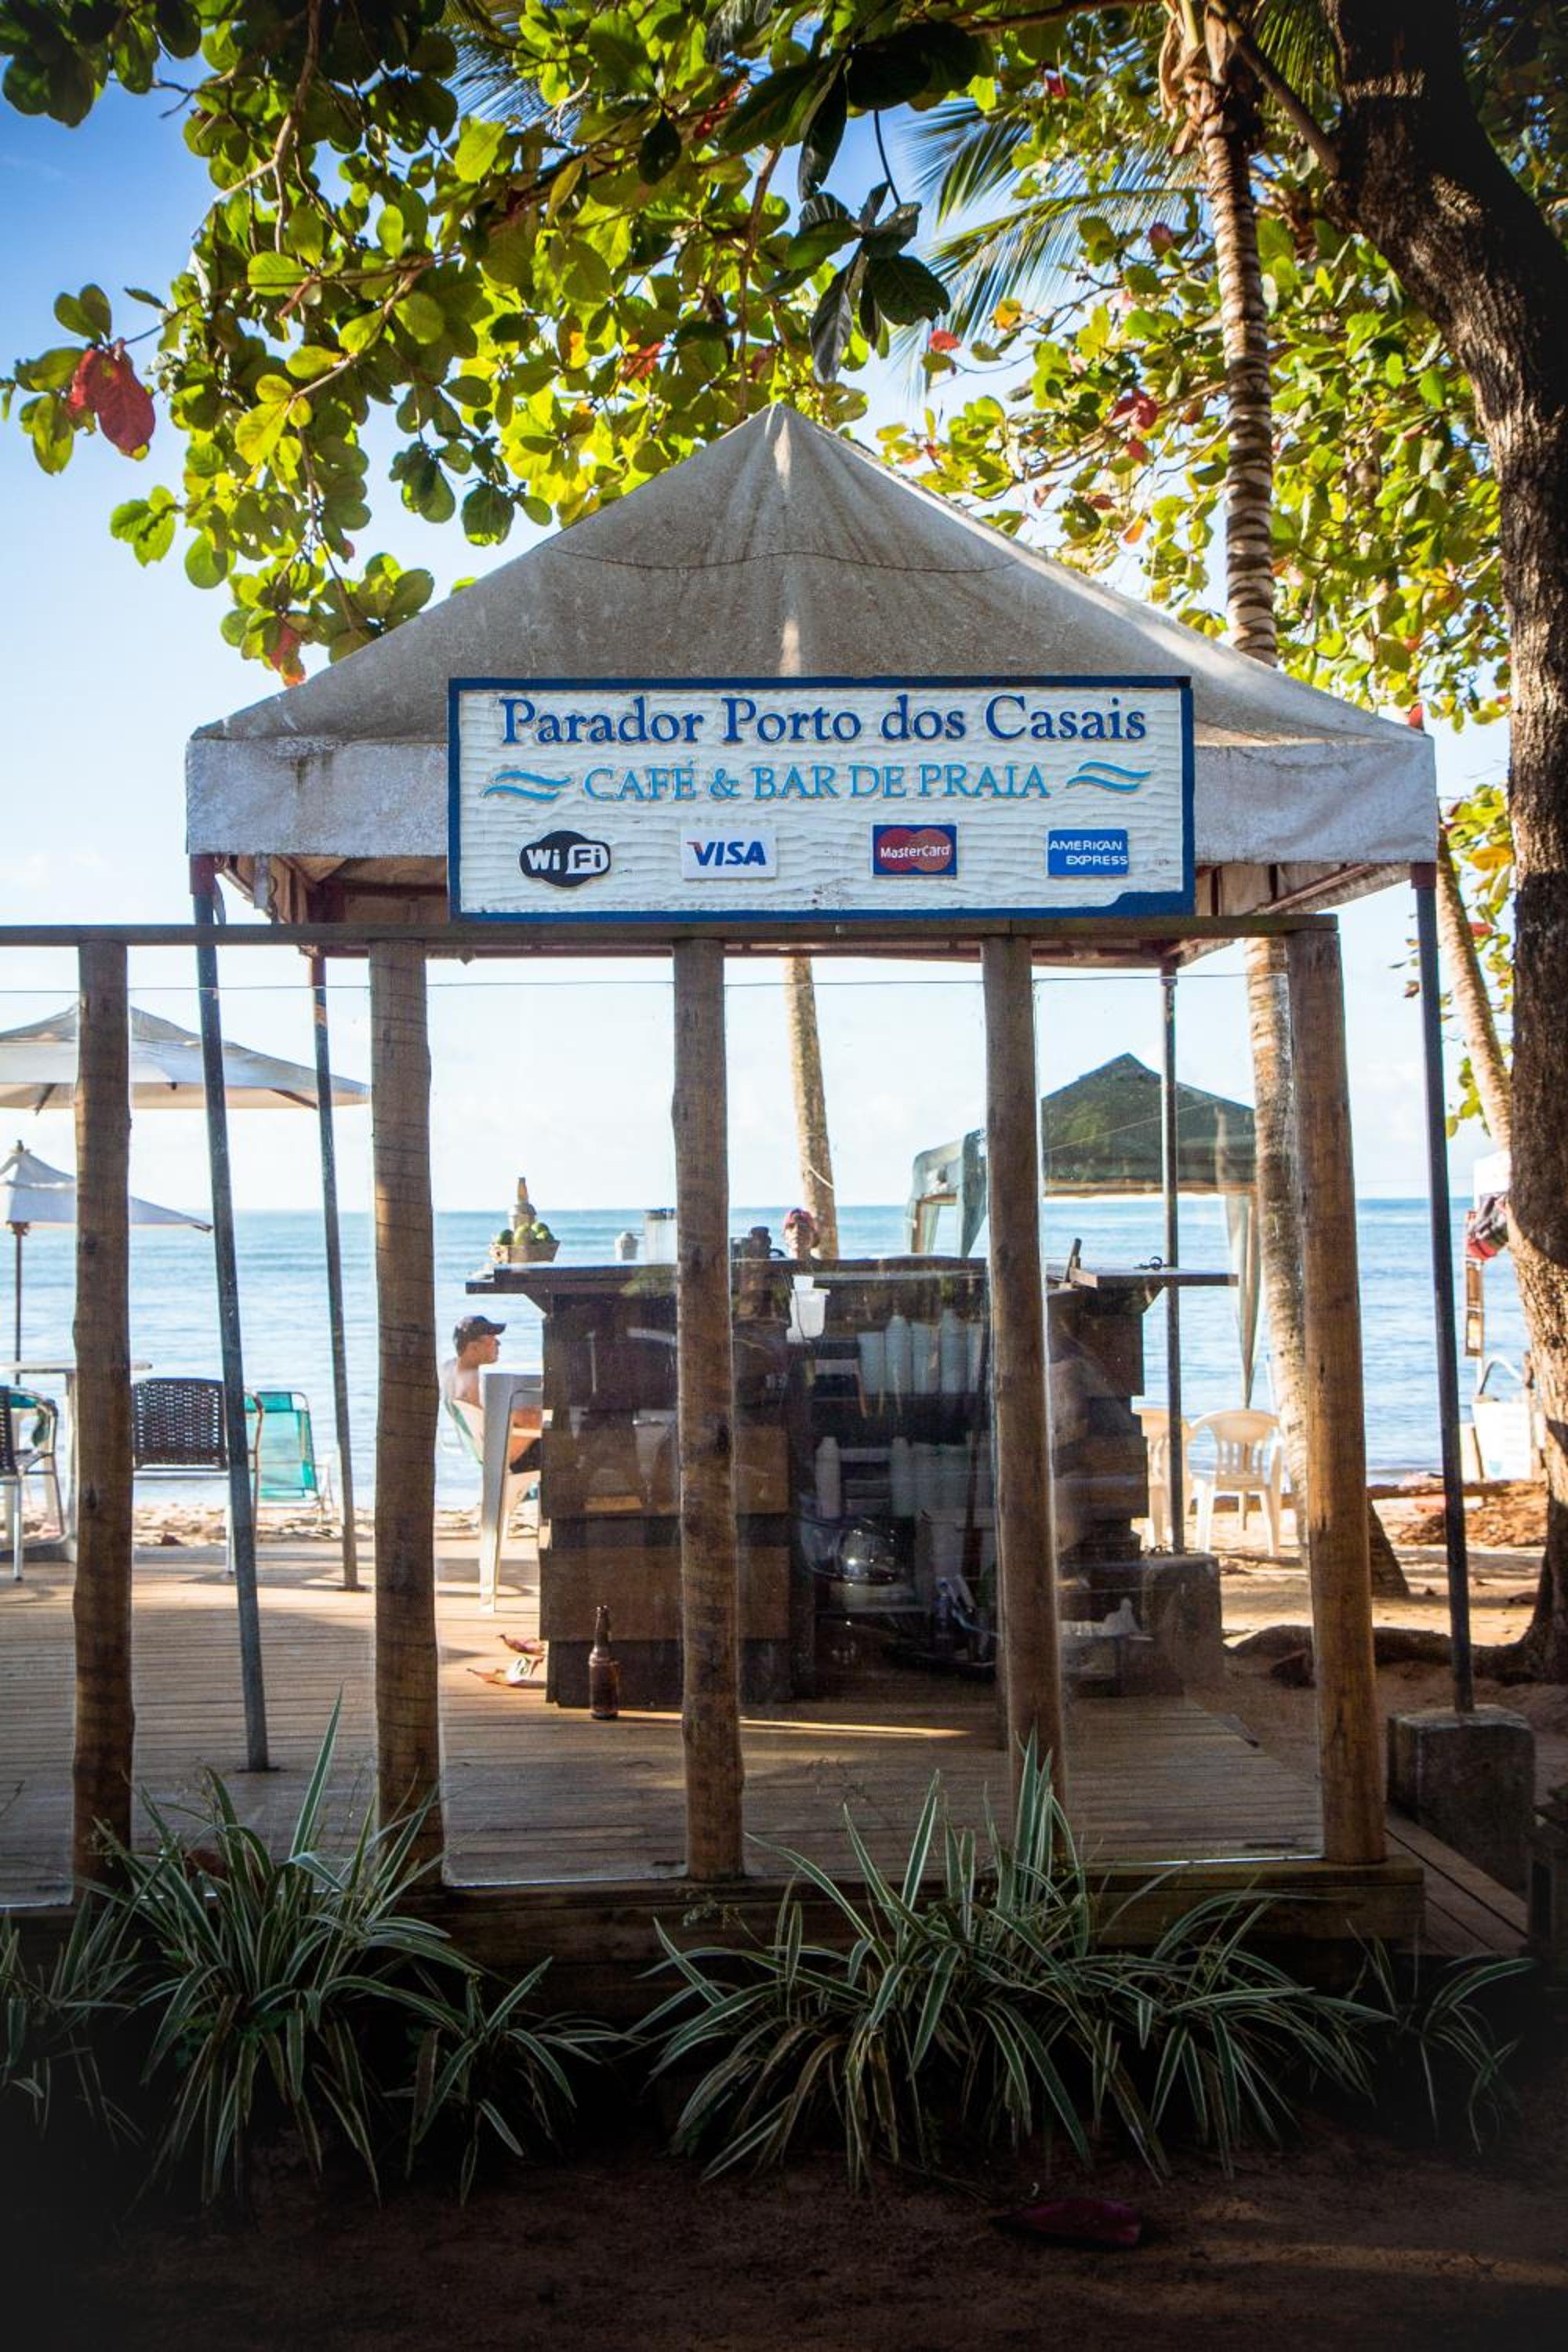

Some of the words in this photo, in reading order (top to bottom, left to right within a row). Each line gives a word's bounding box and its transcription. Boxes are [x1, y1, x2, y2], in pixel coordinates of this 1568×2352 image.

[499, 696, 704, 743] Parador
[721, 697, 862, 742] Porto
[881, 695, 967, 741] dos
[985, 695, 1147, 741] Casais
[584, 760, 696, 800] CAFÉ
[710, 768, 739, 799] &
[752, 765, 839, 800] BAR
[848, 765, 907, 797] DE
[919, 764, 1051, 798] PRAIA
[686, 840, 767, 866] VISA
[880, 844, 951, 858] MasterCard
[1048, 840, 1123, 851] AMERICAN
[1065, 855, 1128, 866] EXPRESS
